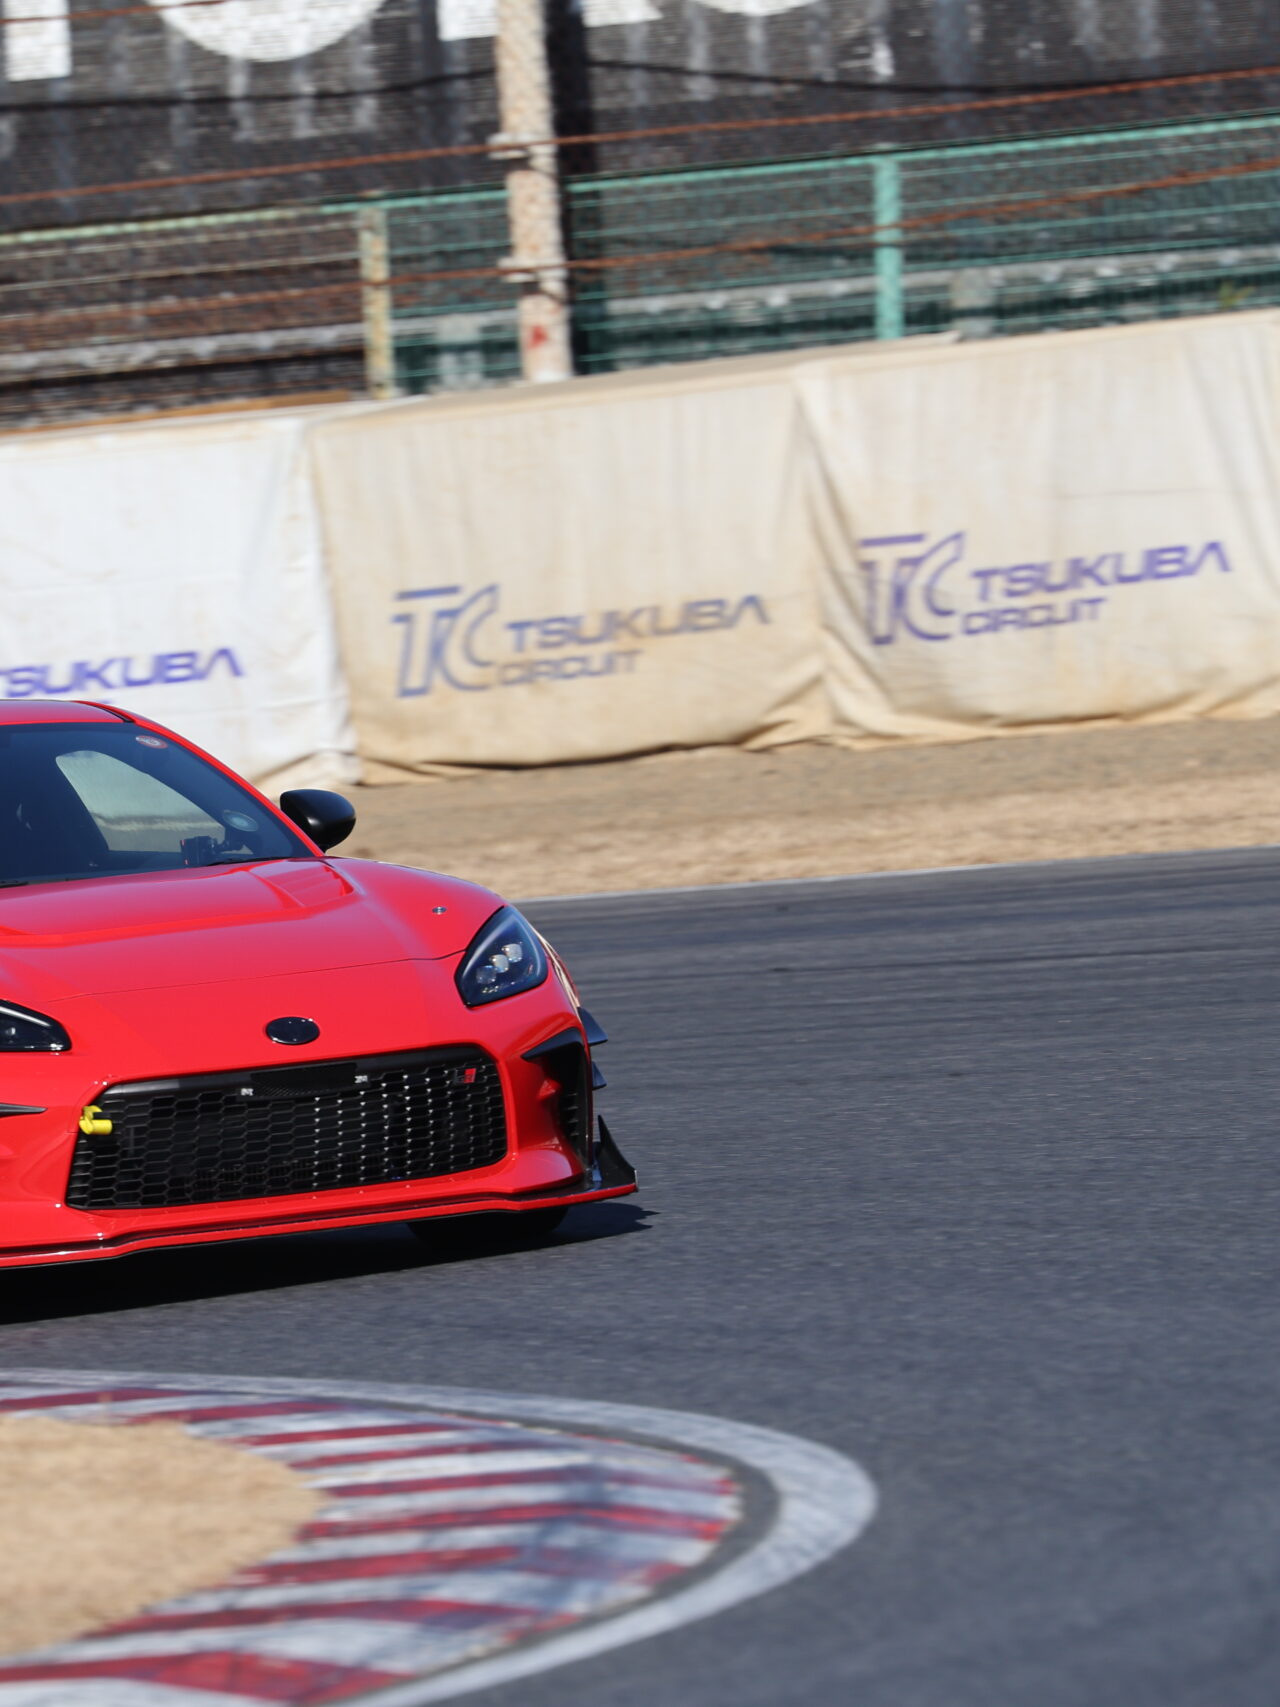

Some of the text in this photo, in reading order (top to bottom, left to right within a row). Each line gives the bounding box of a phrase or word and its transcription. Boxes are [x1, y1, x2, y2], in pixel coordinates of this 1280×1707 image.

[969, 540, 1233, 602] TSUKUBA
[505, 594, 773, 653] TSUKUBA
[961, 596, 1108, 636] CIRCUIT
[496, 648, 645, 687] CIRCUIT
